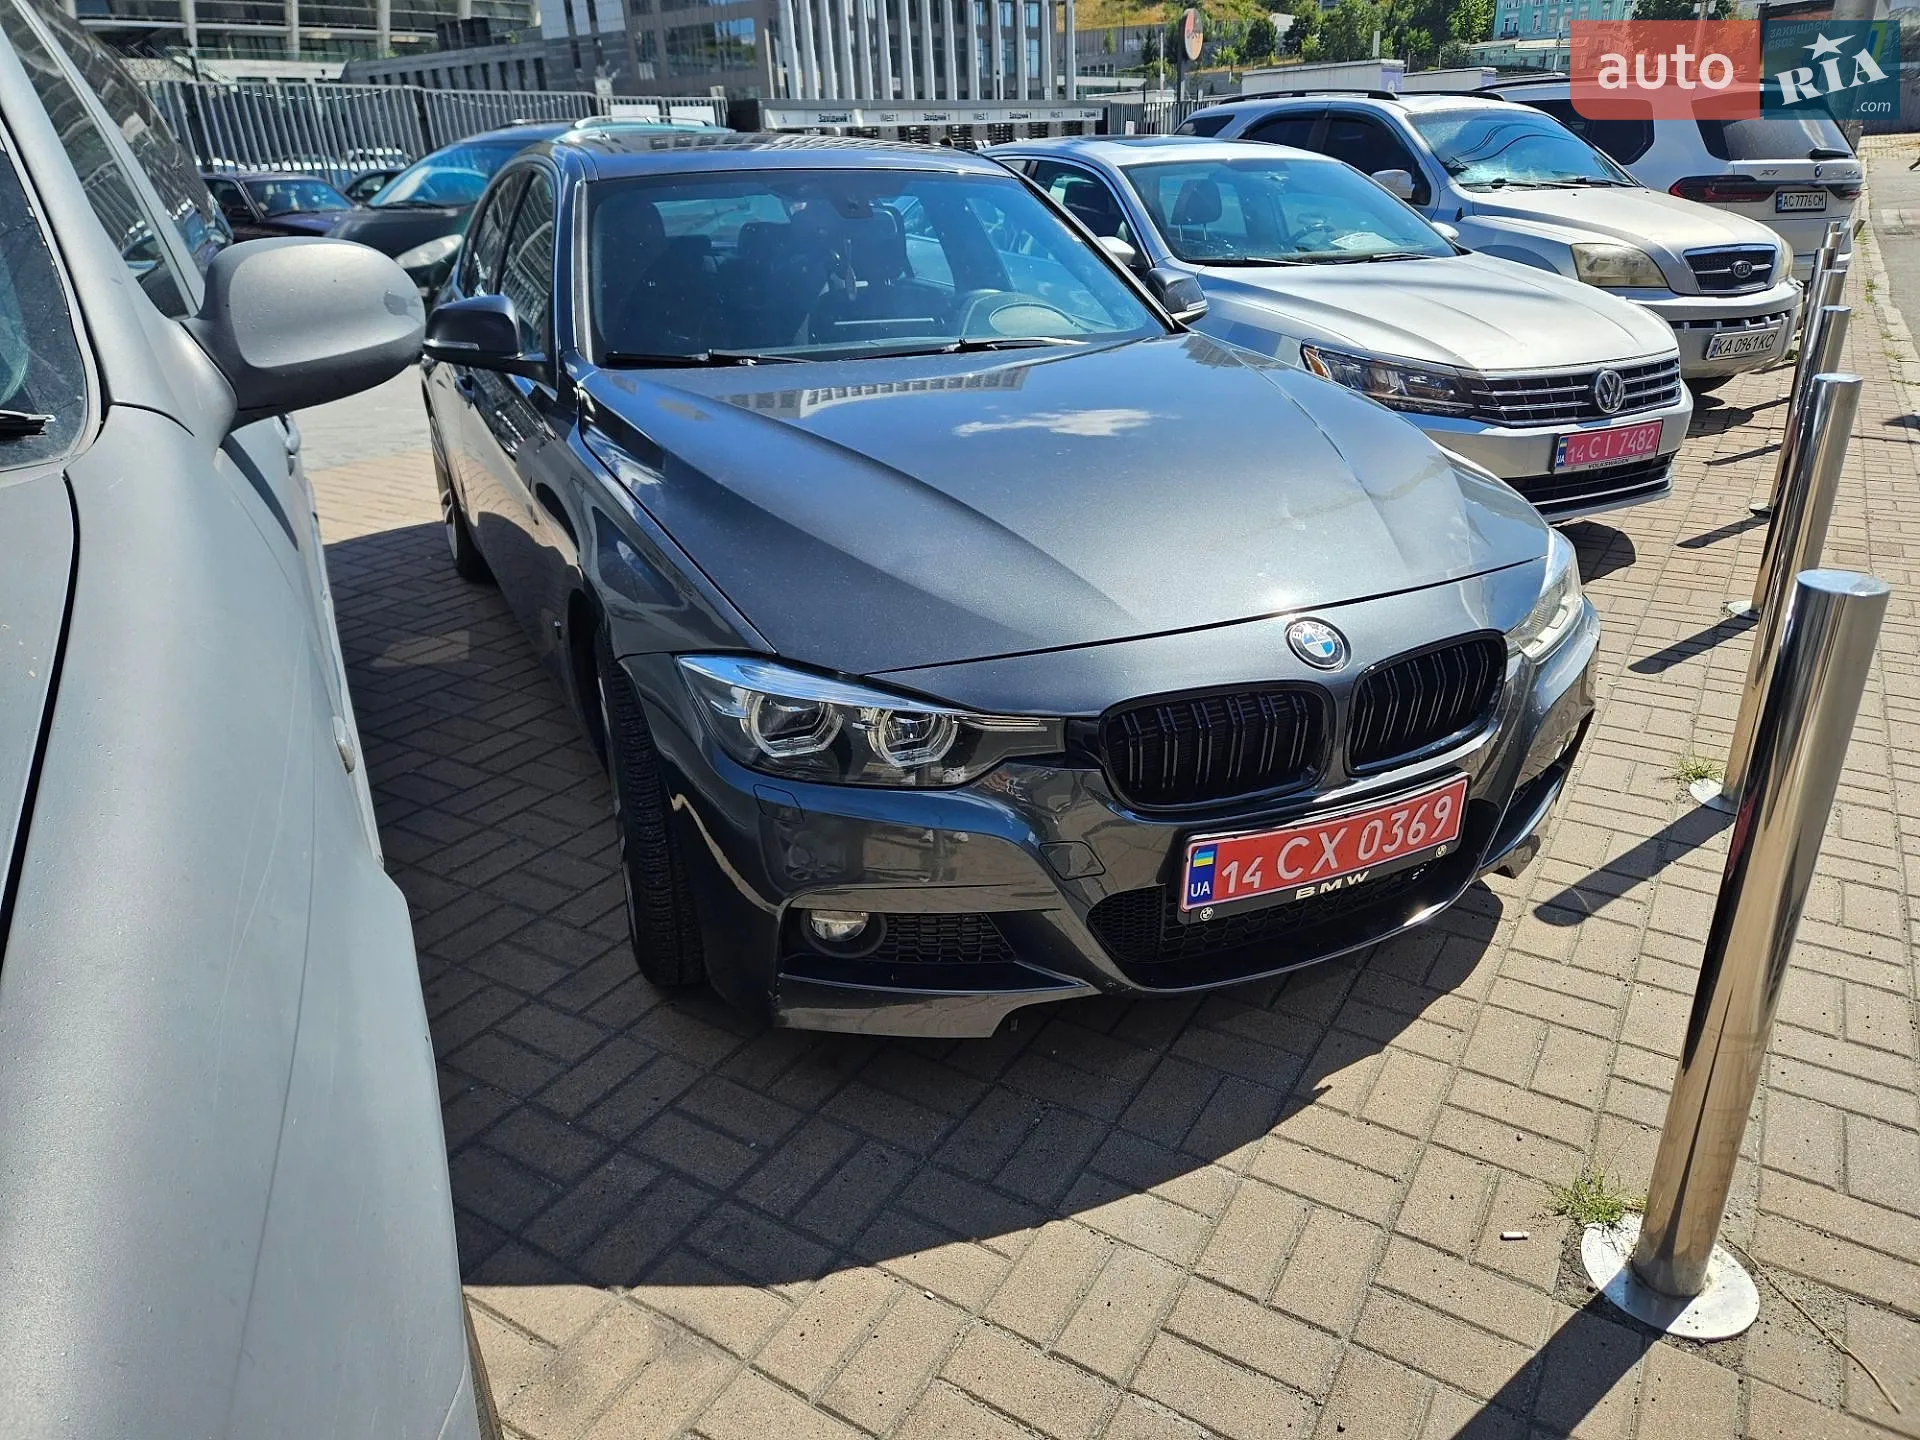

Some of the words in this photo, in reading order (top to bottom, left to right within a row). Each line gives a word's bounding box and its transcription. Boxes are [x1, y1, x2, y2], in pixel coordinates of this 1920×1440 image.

[1783, 194, 1794, 207] AC
[1813, 193, 1824, 206] CM
[1720, 340, 1732, 354] KA
[1734, 336, 1758, 352] 0961
[1760, 334, 1775, 349] KC
[1569, 445, 1585, 462] 14
[1588, 435, 1612, 459] CI
[1618, 428, 1656, 455] 7482
[1221, 856, 1264, 893] 14
[1277, 827, 1347, 880] CX
[1357, 795, 1452, 861] 0369
[1190, 882, 1211, 897] UA
[1295, 870, 1370, 900] BMW
